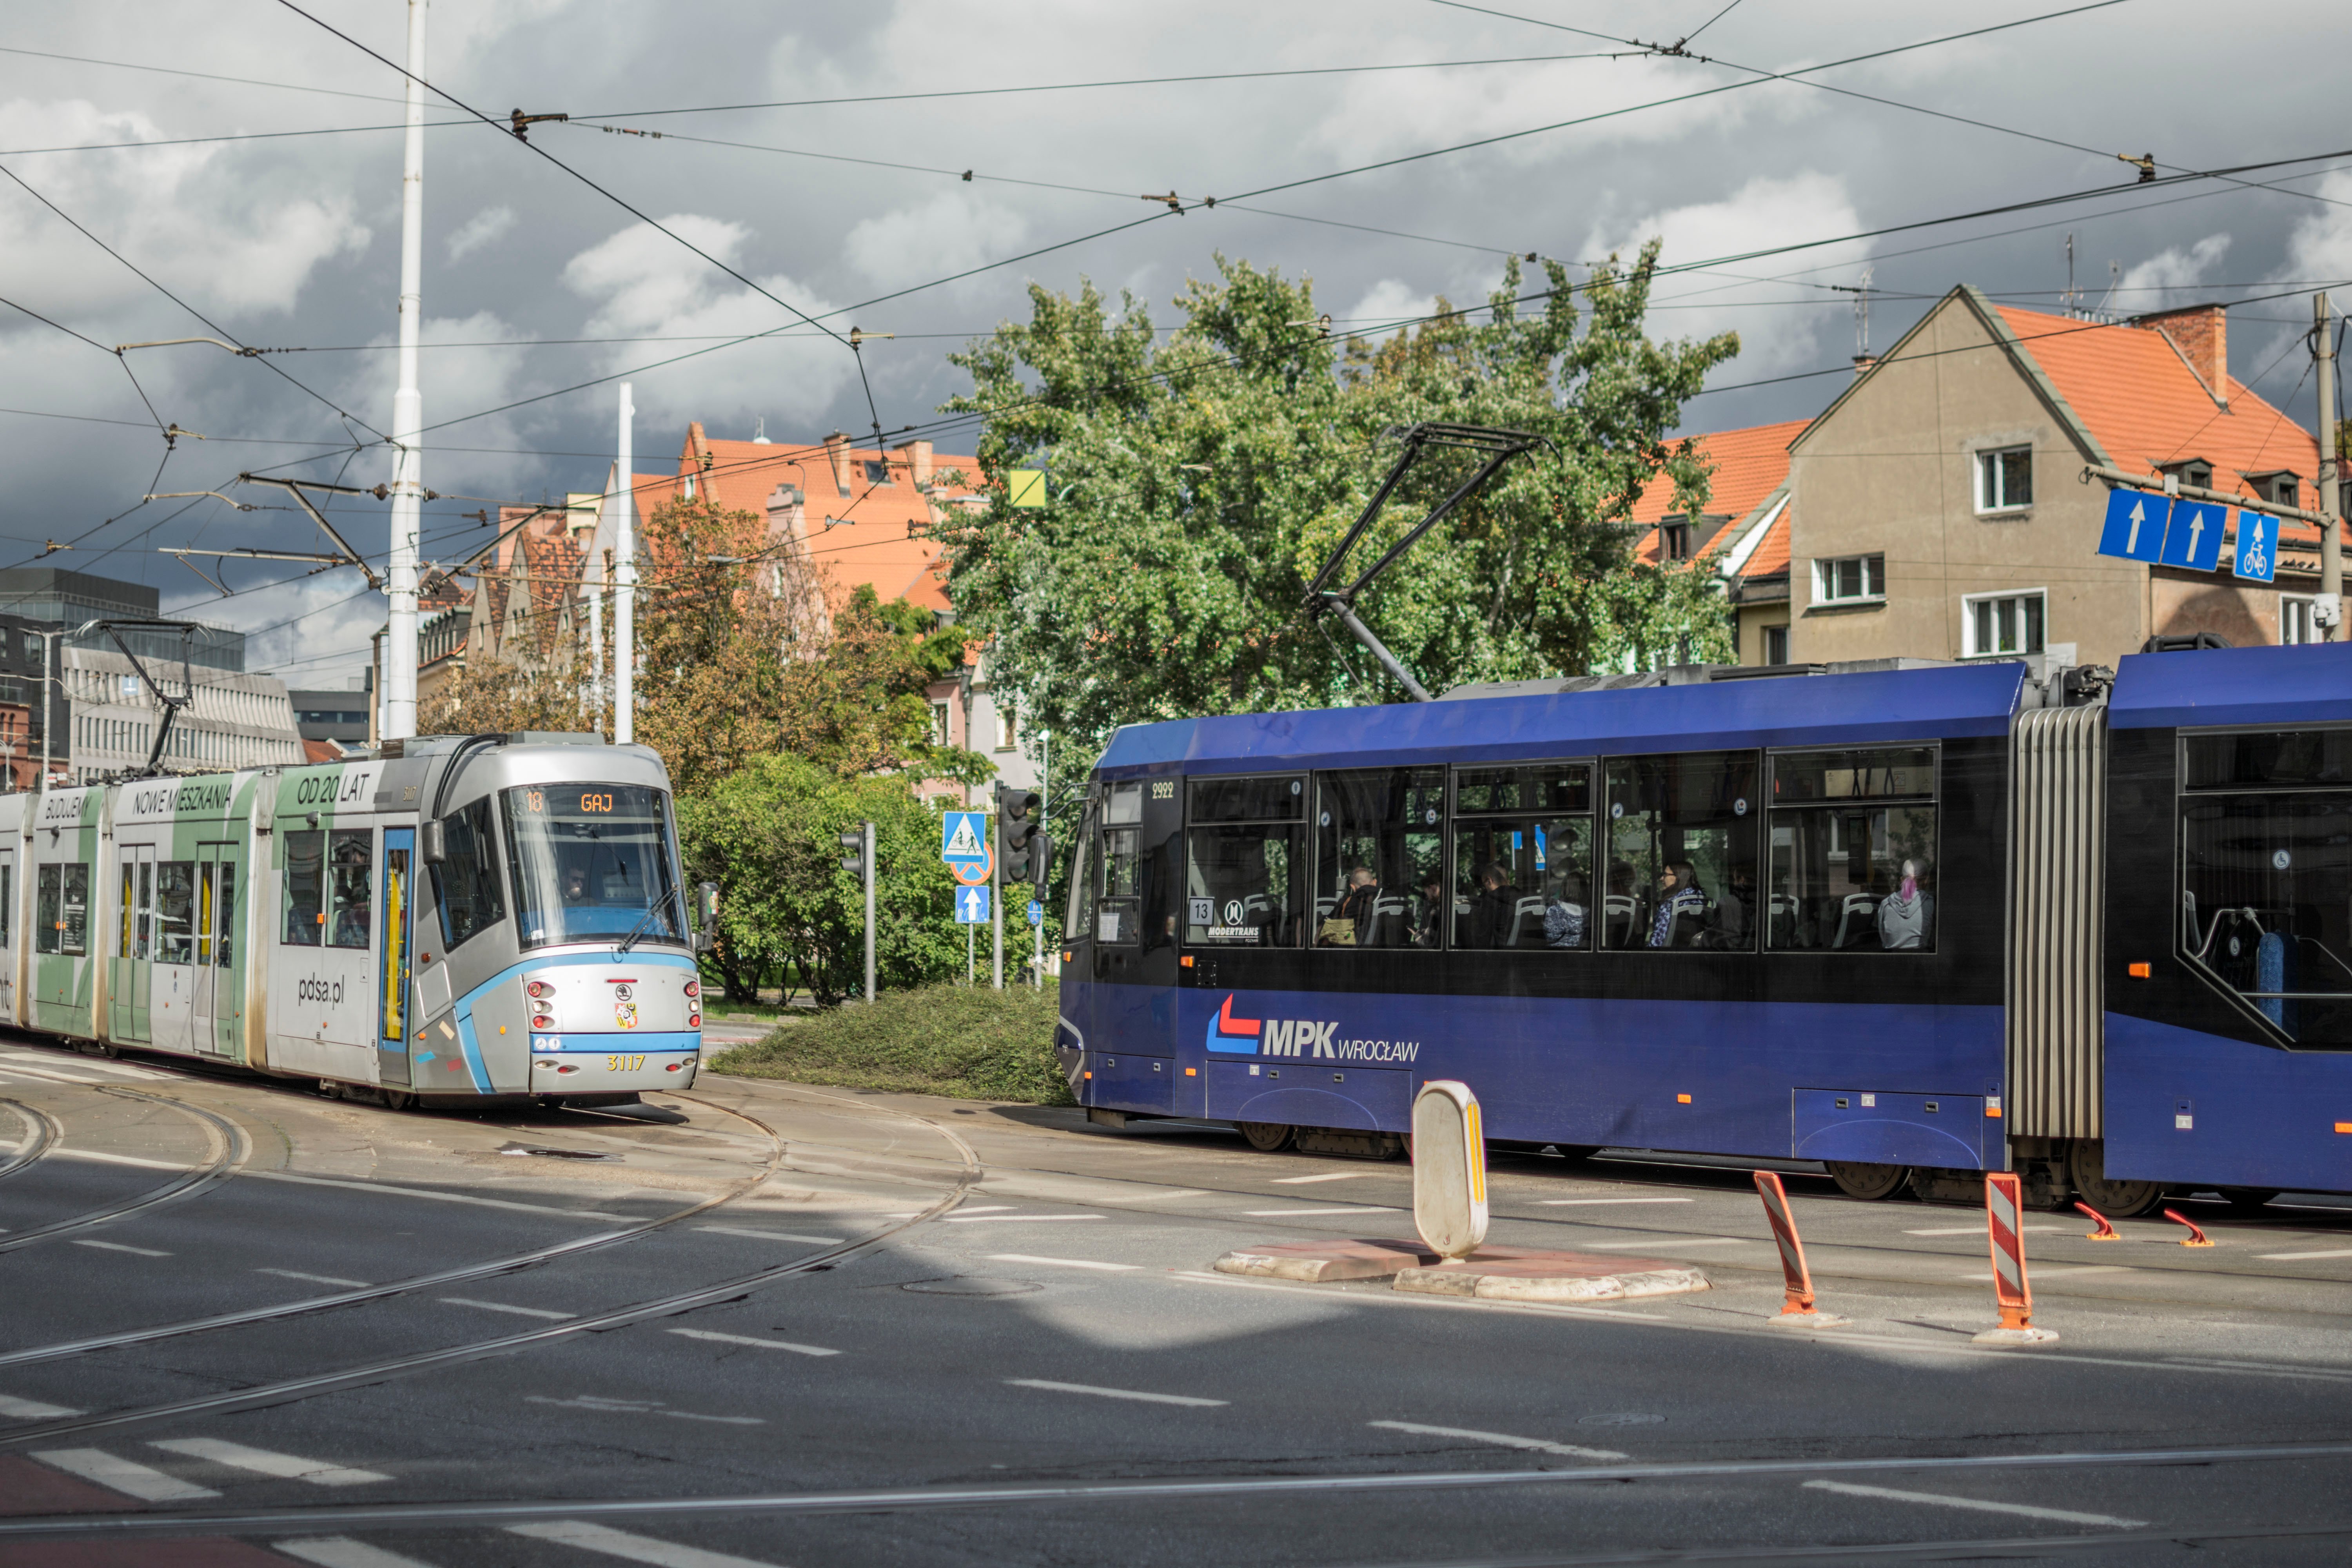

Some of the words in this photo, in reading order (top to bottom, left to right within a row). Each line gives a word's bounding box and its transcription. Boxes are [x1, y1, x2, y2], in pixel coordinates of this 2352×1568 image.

[298, 777, 319, 804] OD
[320, 775, 339, 803] 20
[341, 773, 370, 802] LAT
[403, 786, 417, 801] 3117
[1152, 782, 1173, 799] 2922
[46, 795, 93, 819] BUDUJEMY
[132, 789, 167, 815] NOWE
[166, 784, 232, 811] MIESZKANIA
[526, 792, 542, 812] 18
[581, 794, 612, 812] GAJ
[1195, 903, 1208, 918] 13
[1208, 927, 1259, 936] MODERTRANS
[298, 972, 344, 1011] pdsa.pl
[1263, 1020, 1339, 1058] MPK
[1338, 1040, 1419, 1062] WROCŁAW
[607, 1054, 645, 1071] 3117
